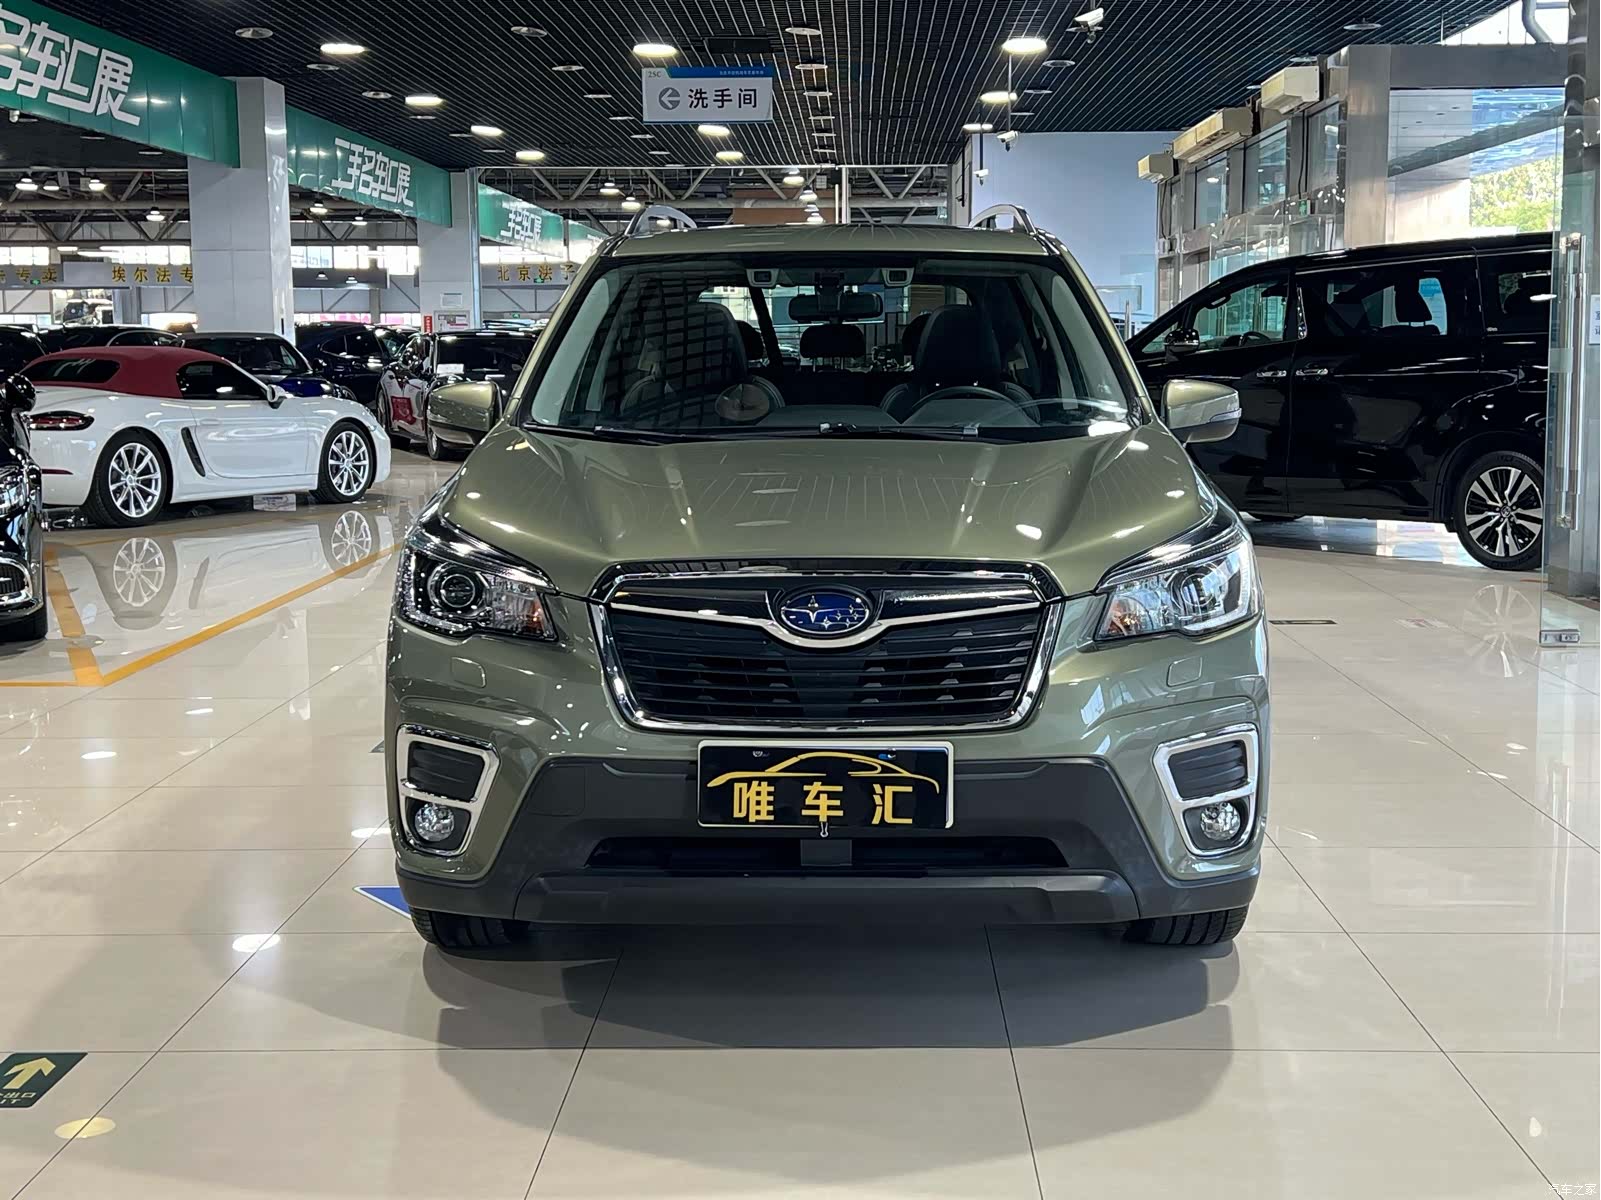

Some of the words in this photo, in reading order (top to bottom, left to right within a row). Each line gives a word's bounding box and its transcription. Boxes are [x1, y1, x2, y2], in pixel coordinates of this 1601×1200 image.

[688, 88, 757, 108] 洗手间
[331, 137, 415, 208] 二手名车汇展
[733, 780, 913, 825] 唯车汇
